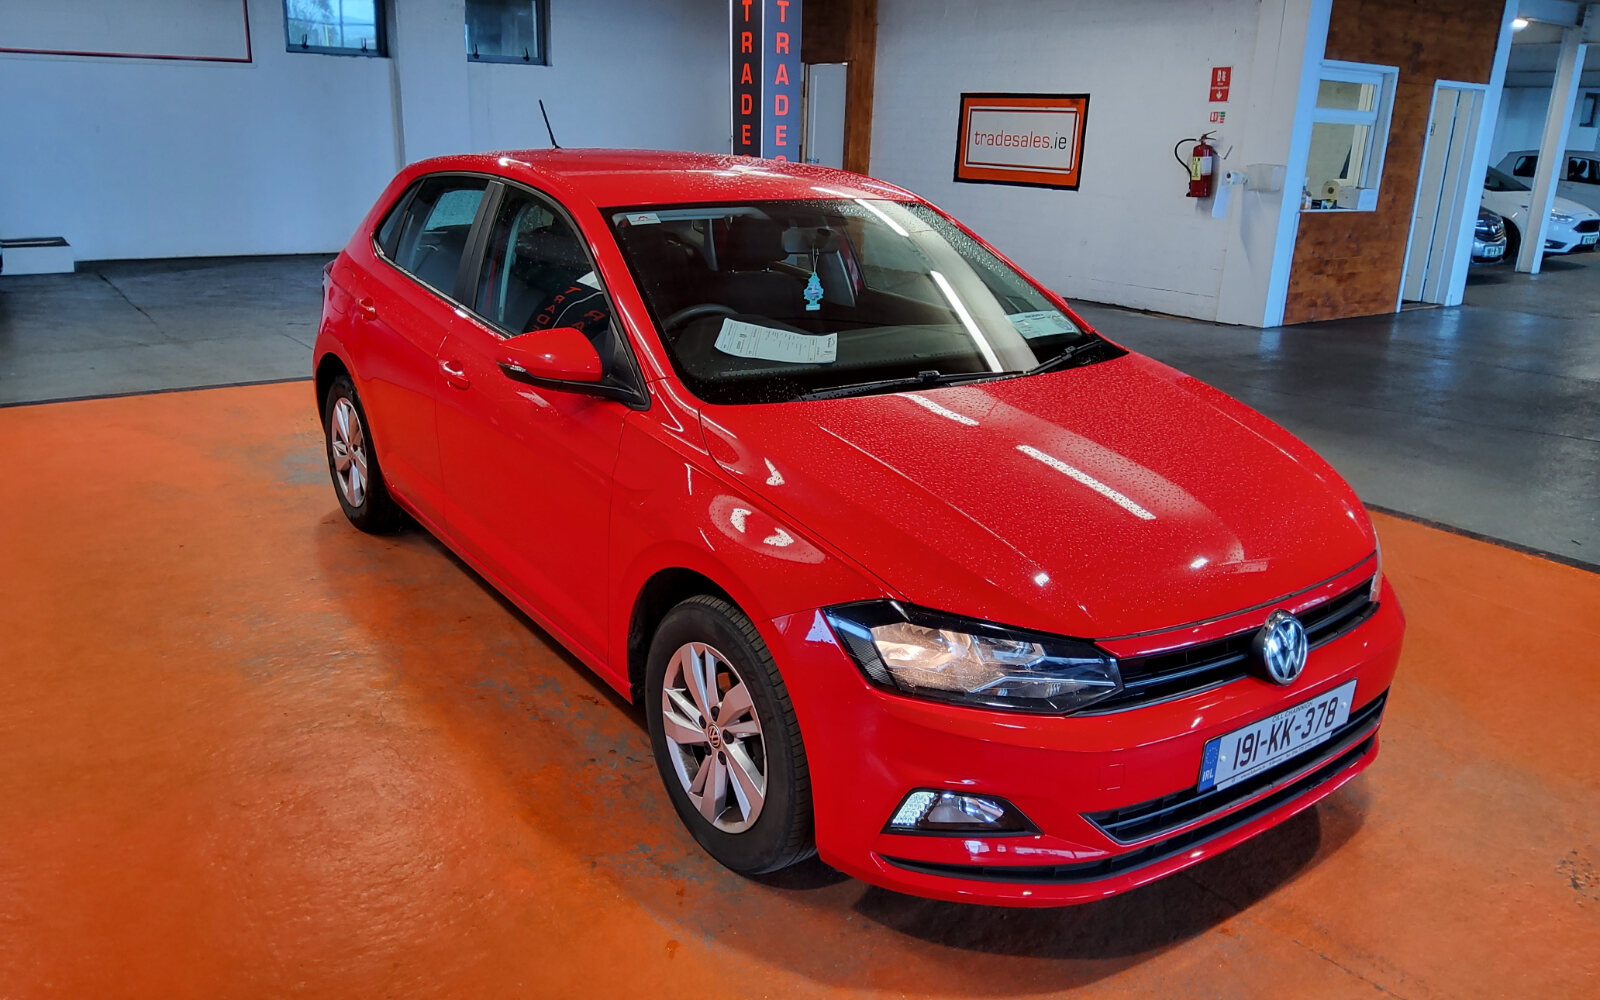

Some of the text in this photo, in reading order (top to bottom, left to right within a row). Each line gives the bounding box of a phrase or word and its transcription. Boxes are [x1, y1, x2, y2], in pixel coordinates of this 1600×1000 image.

[741, 0, 753, 157] TRADE
[775, 0, 790, 162] TRADE
[974, 129, 1067, 150] tradesales.ie
[1232, 696, 1339, 771] 191-KK-378
[1202, 767, 1214, 783] IRL
